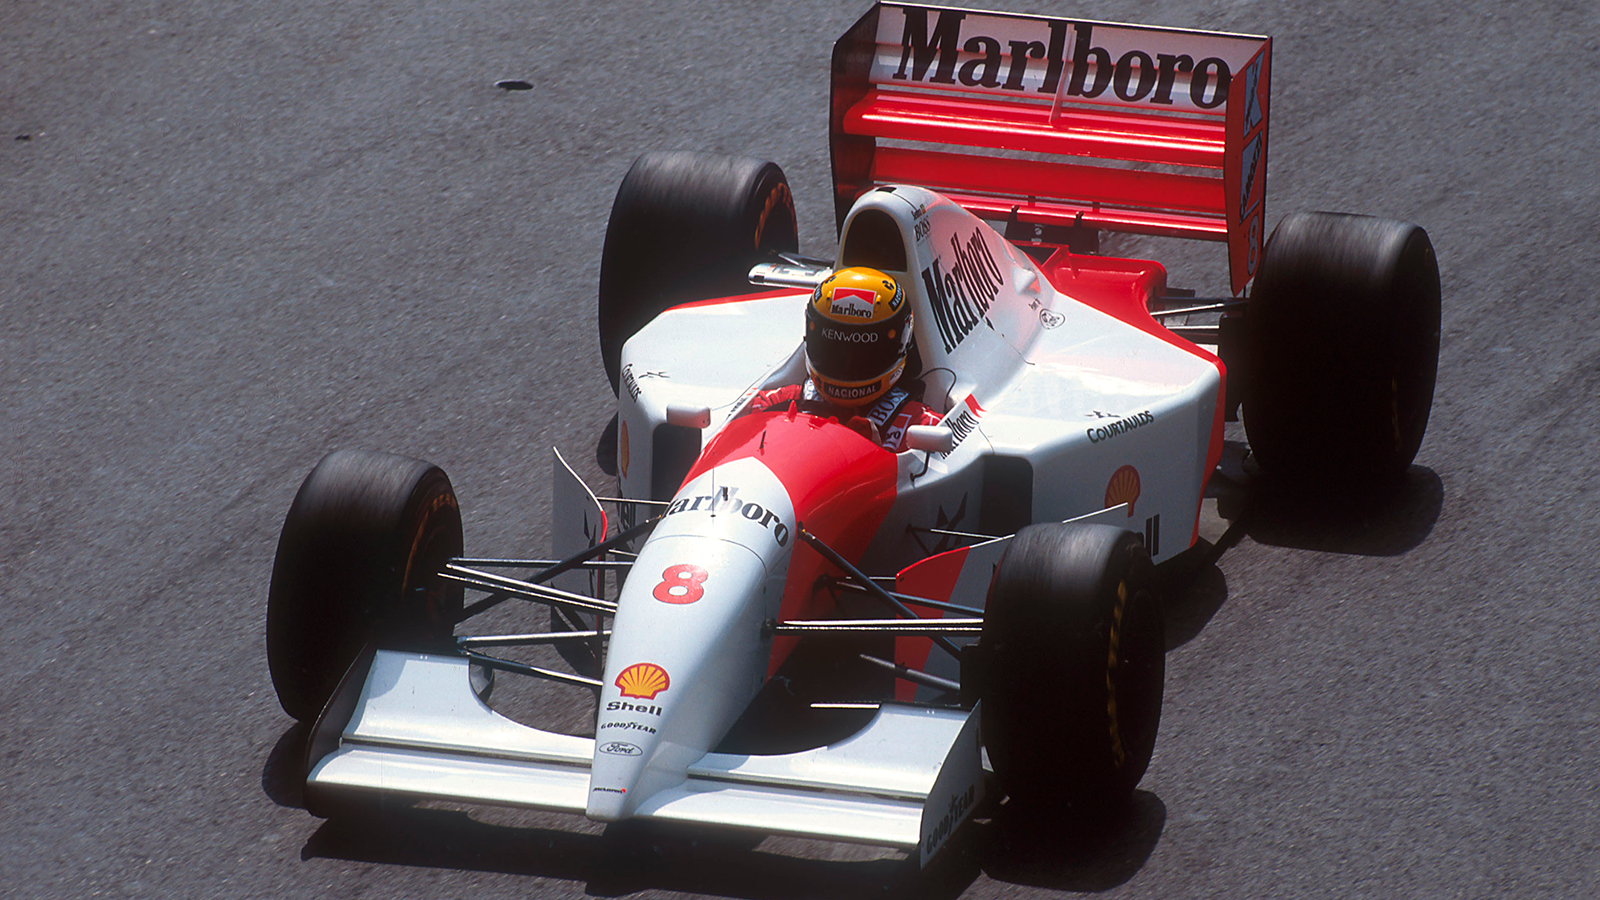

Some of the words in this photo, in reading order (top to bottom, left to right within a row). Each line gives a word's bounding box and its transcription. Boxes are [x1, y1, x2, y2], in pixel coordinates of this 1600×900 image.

[892, 7, 1234, 110] Marlboro
[1247, 213, 1259, 276] 8
[921, 226, 1003, 355] Marlboro
[832, 303, 872, 318] Marlboro
[821, 327, 878, 343] KENWOOD
[828, 385, 876, 398] NACIONAL
[1087, 410, 1154, 444] COURTAULDS
[661, 486, 789, 548] arlboro
[653, 564, 709, 605] 8
[606, 701, 662, 716] Shell
[601, 721, 656, 735] GOODYEAR
[607, 742, 635, 754] Ford
